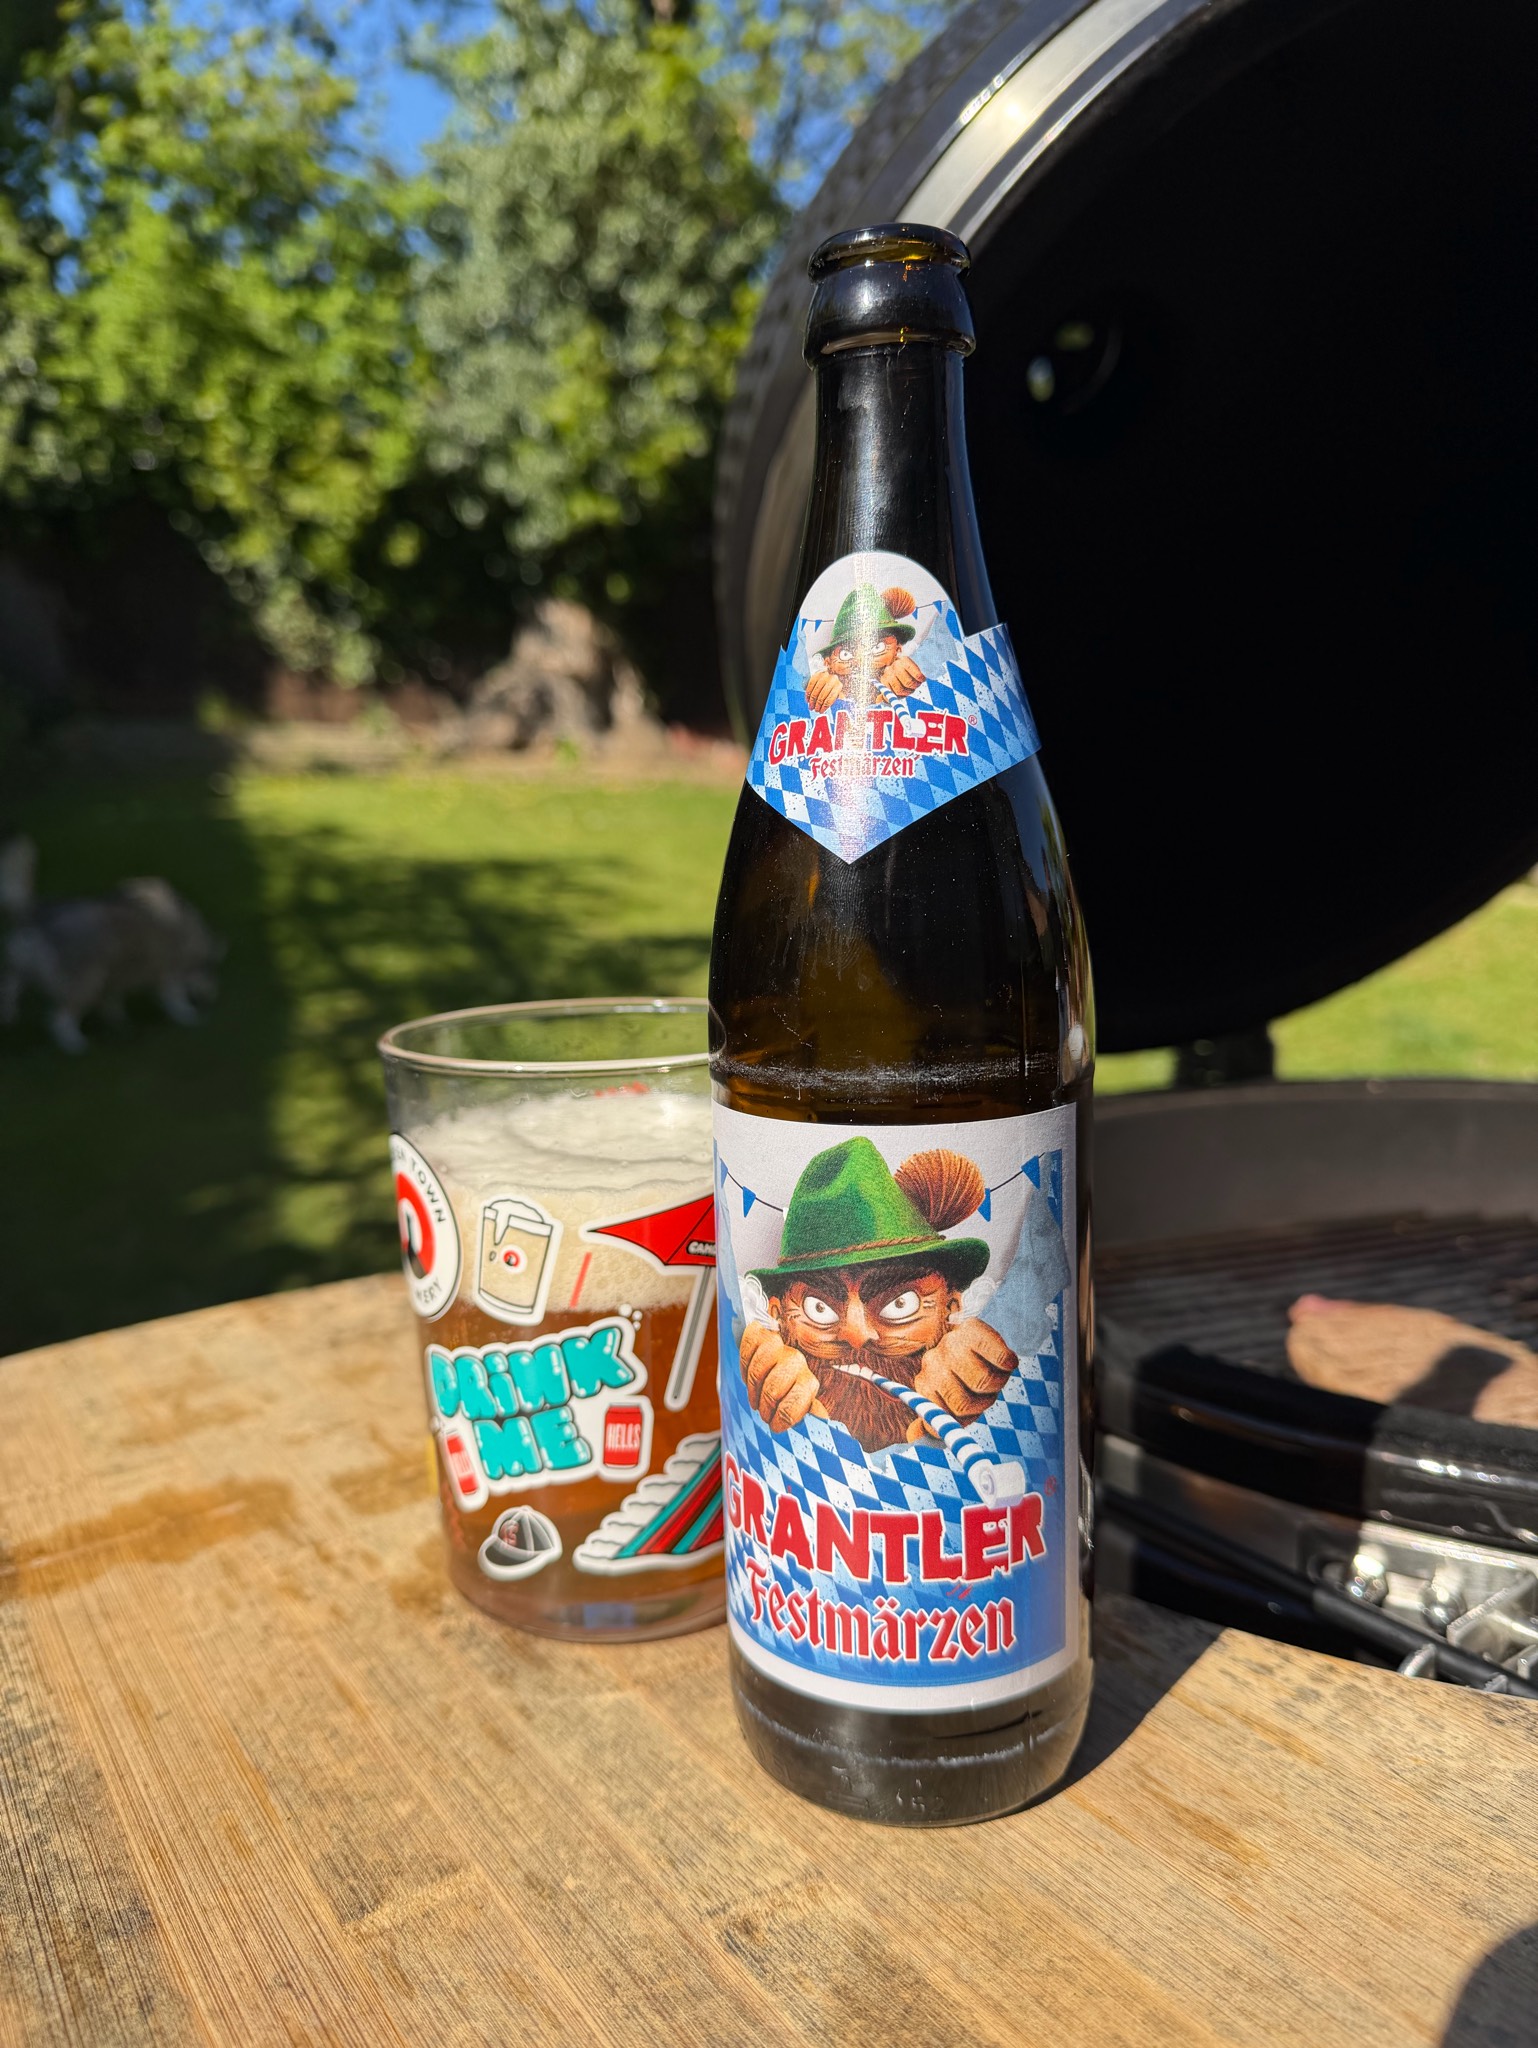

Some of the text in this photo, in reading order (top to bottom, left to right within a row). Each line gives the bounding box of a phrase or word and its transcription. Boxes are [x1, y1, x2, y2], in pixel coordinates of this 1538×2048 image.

[768, 709, 969, 765] GRANTLER
[411, 1157, 447, 1223] TOWN
[687, 1240, 717, 1257] CAM
[472, 1405, 593, 1481] ME
[605, 1422, 642, 1452] HELLS
[724, 1452, 1047, 1584] GRANTLER
[746, 1560, 1016, 1662] Festmärzen
